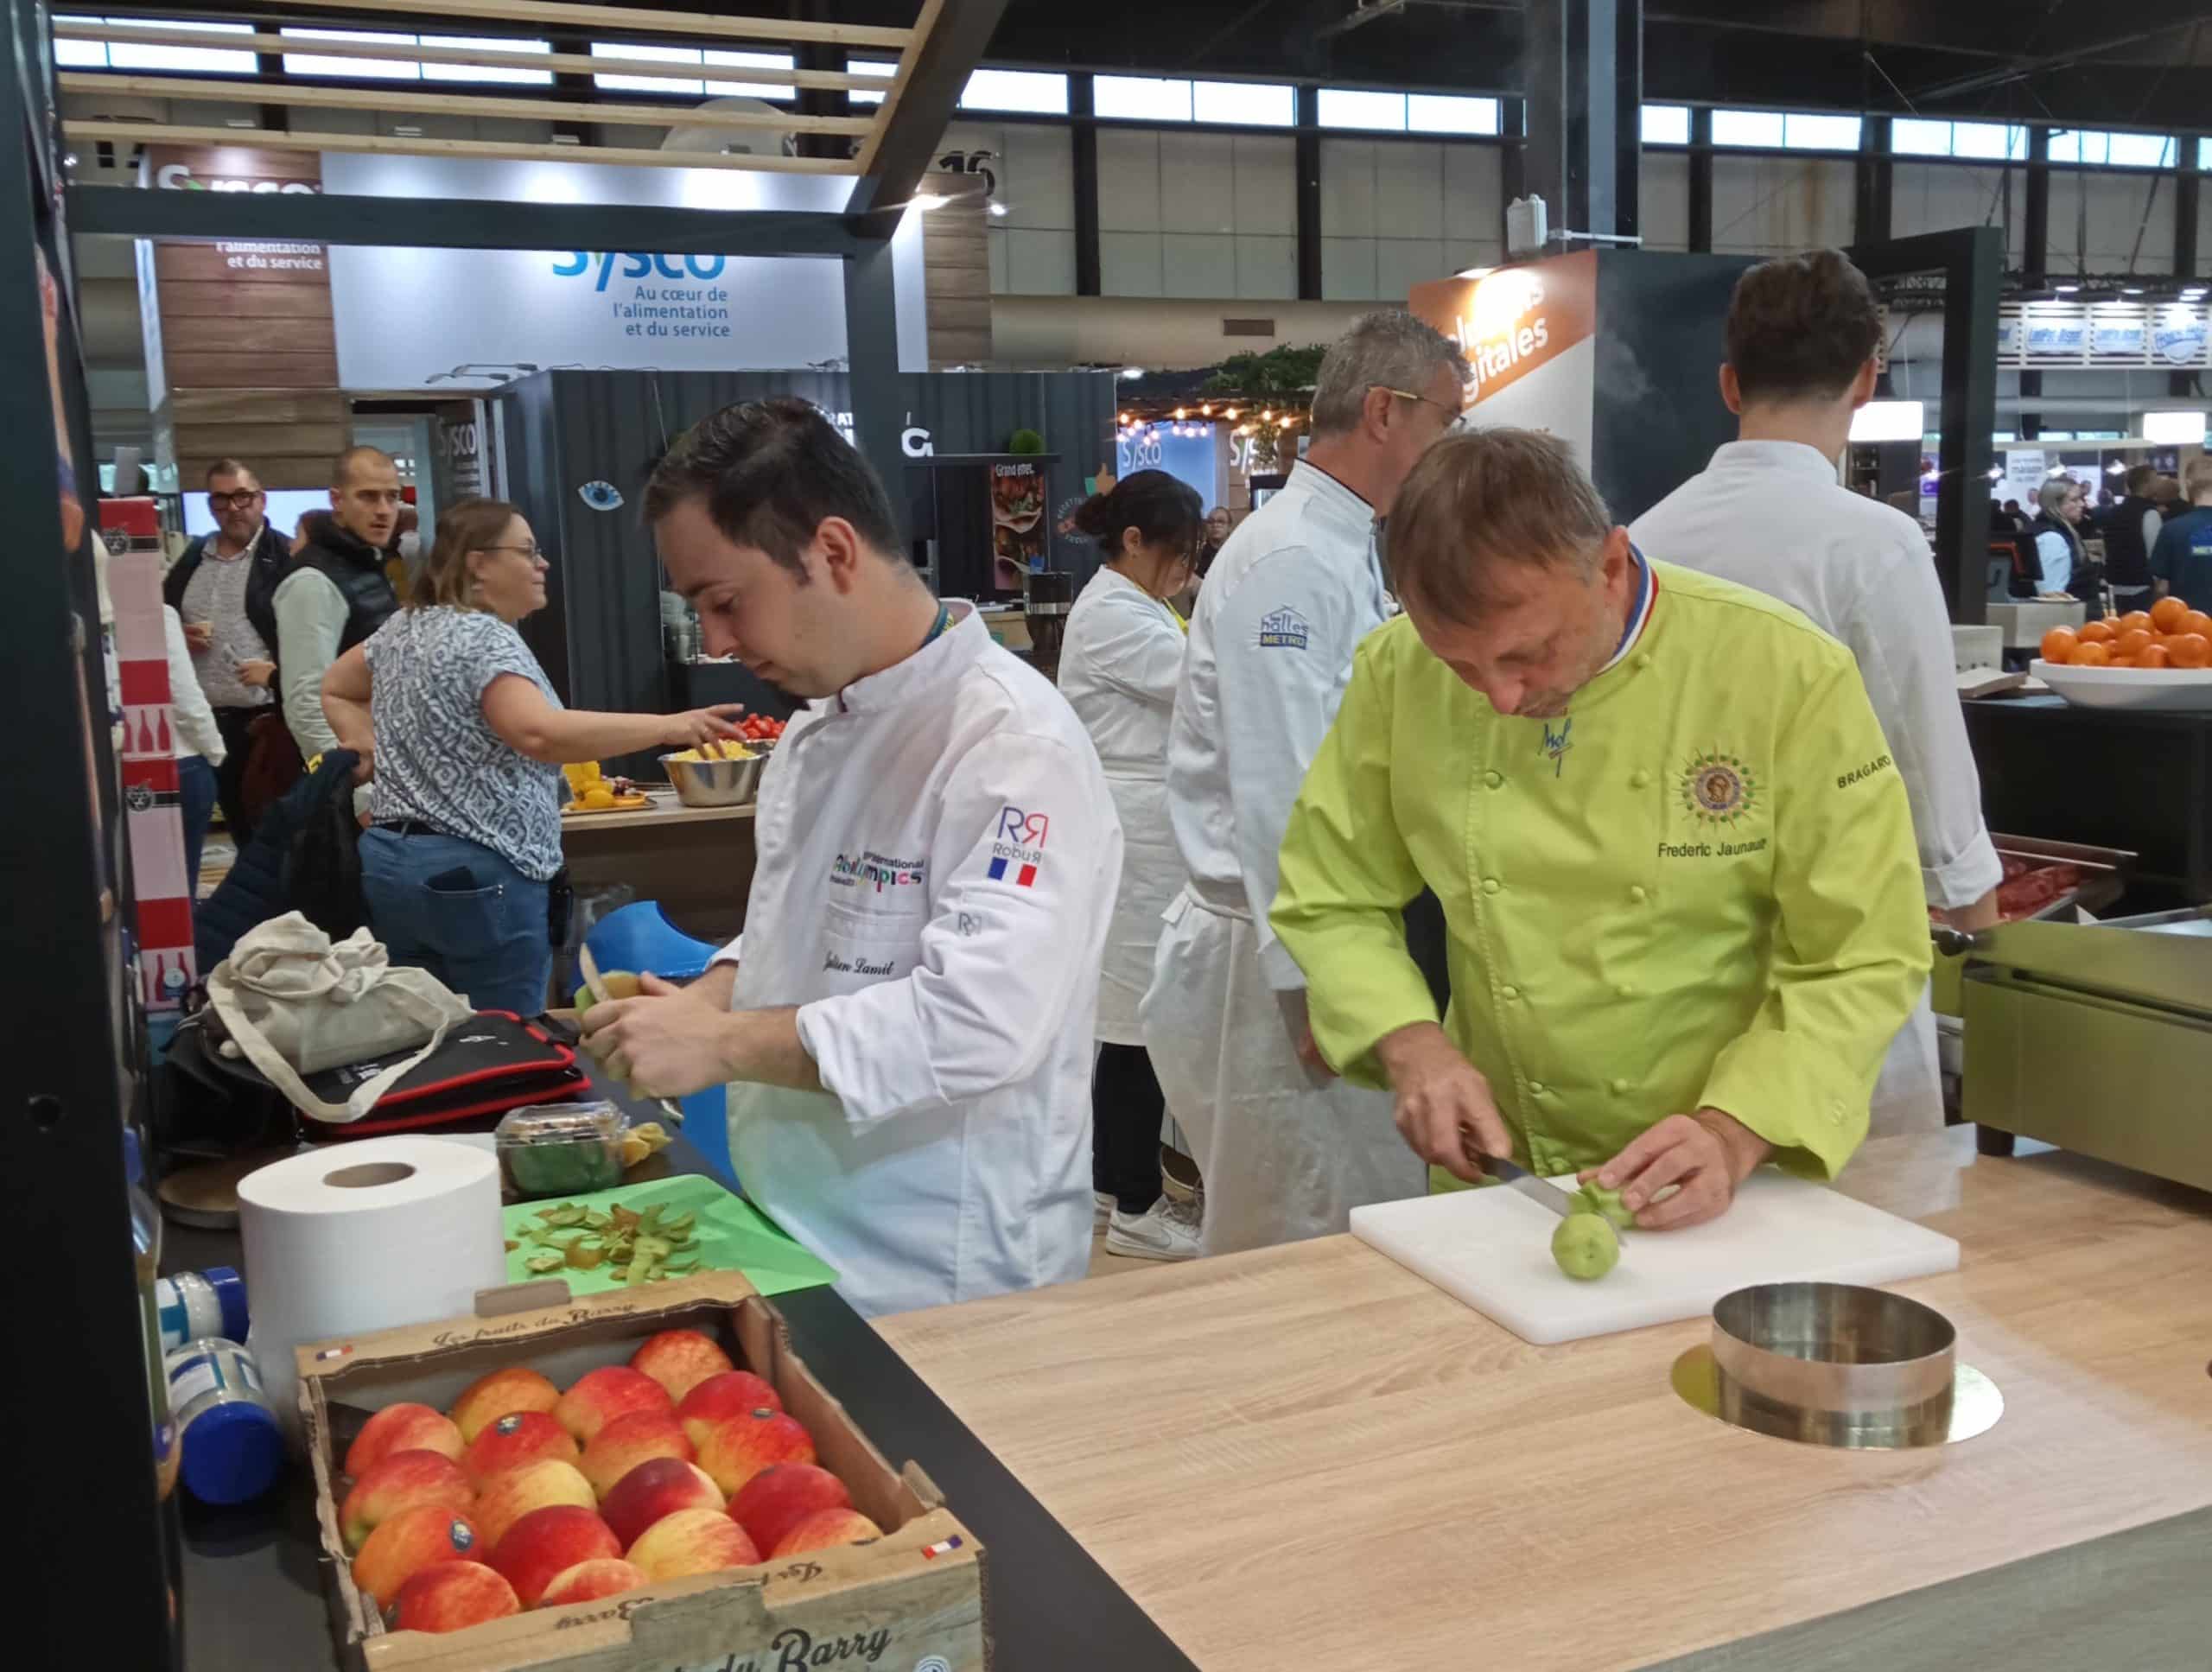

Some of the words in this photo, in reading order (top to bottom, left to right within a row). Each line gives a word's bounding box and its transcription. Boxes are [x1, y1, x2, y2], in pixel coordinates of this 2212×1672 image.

[227, 257, 244, 268] et
[246, 255, 267, 269] du
[270, 257, 323, 270] service
[635, 285, 657, 302] Au
[661, 287, 702, 302] cœur
[707, 287, 728, 302] de
[613, 303, 728, 319] l'alimentation
[626, 323, 644, 336] et
[647, 321, 668, 336] du
[673, 322, 730, 337] service
[1658, 842, 1712, 857] Frederic
[771, 1628, 892, 1672] Barry
